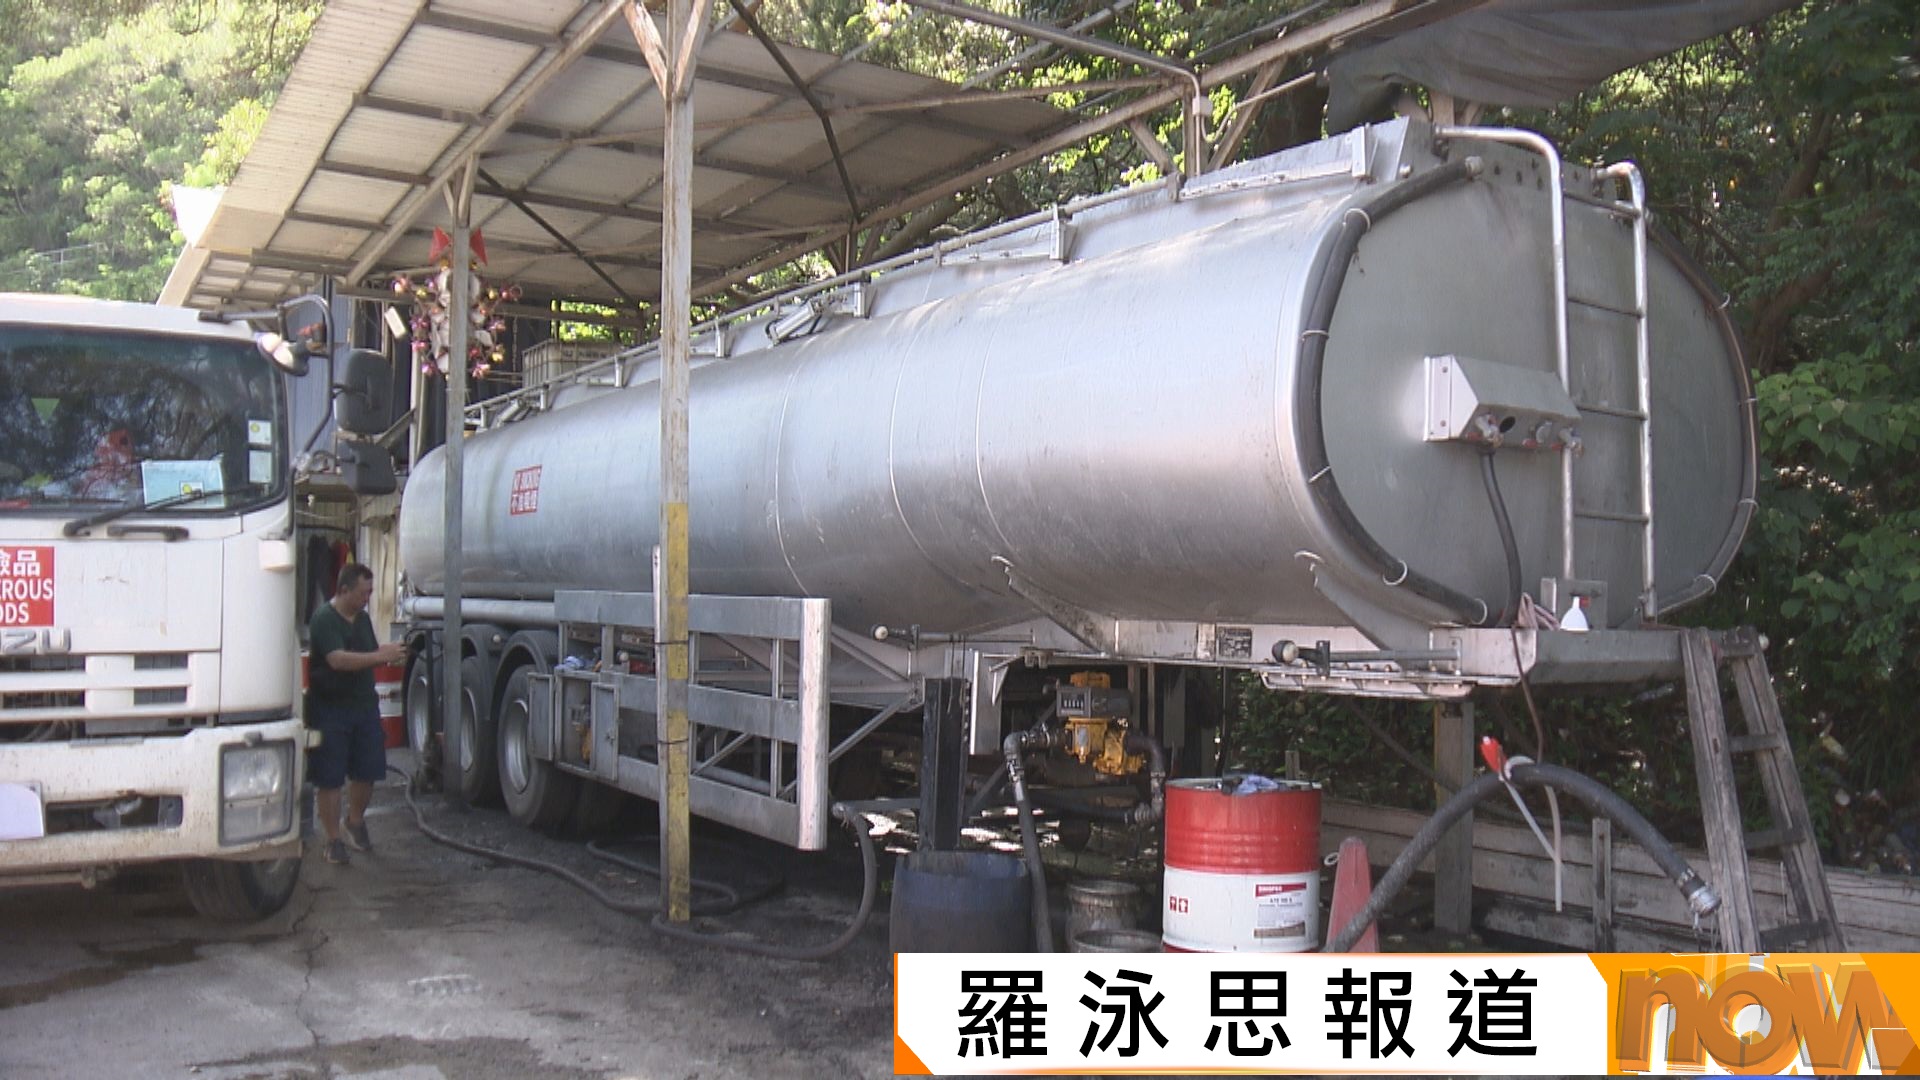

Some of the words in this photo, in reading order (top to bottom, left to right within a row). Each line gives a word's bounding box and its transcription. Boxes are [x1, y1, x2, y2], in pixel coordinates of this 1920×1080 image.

[0, 578, 53, 601] ROUS
[0, 601, 30, 623] DS
[0, 628, 72, 656] ZU
